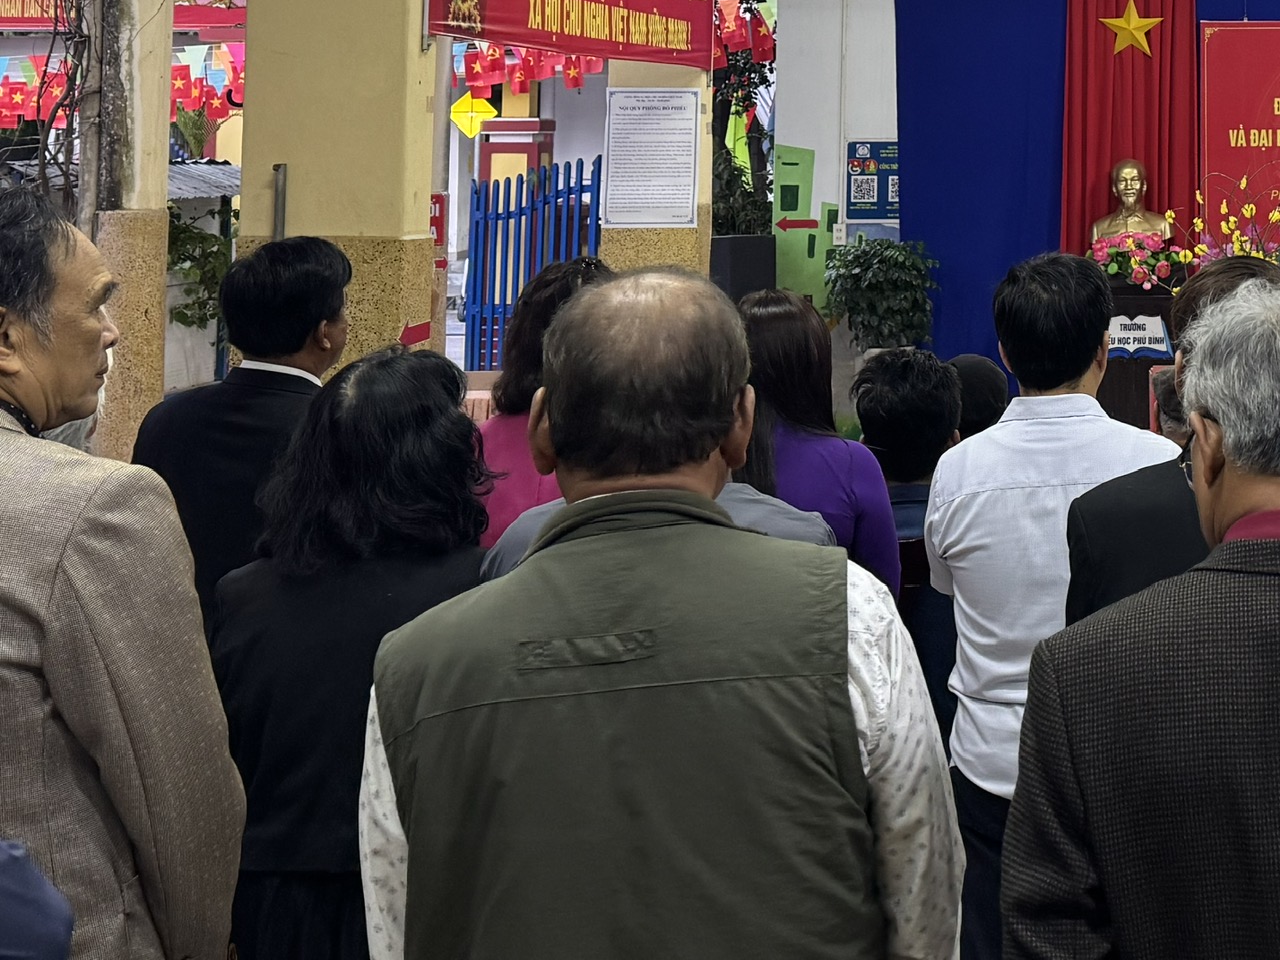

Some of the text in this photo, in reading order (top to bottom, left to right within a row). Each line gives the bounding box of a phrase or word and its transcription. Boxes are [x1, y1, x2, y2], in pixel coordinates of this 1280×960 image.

[612, 0, 628, 50] VIỆT
[630, 10, 647, 45] NAM
[1229, 124, 1246, 147] VÀ
[1250, 129, 1272, 151] ĐẠI
[1117, 336, 1131, 346] HỌC
